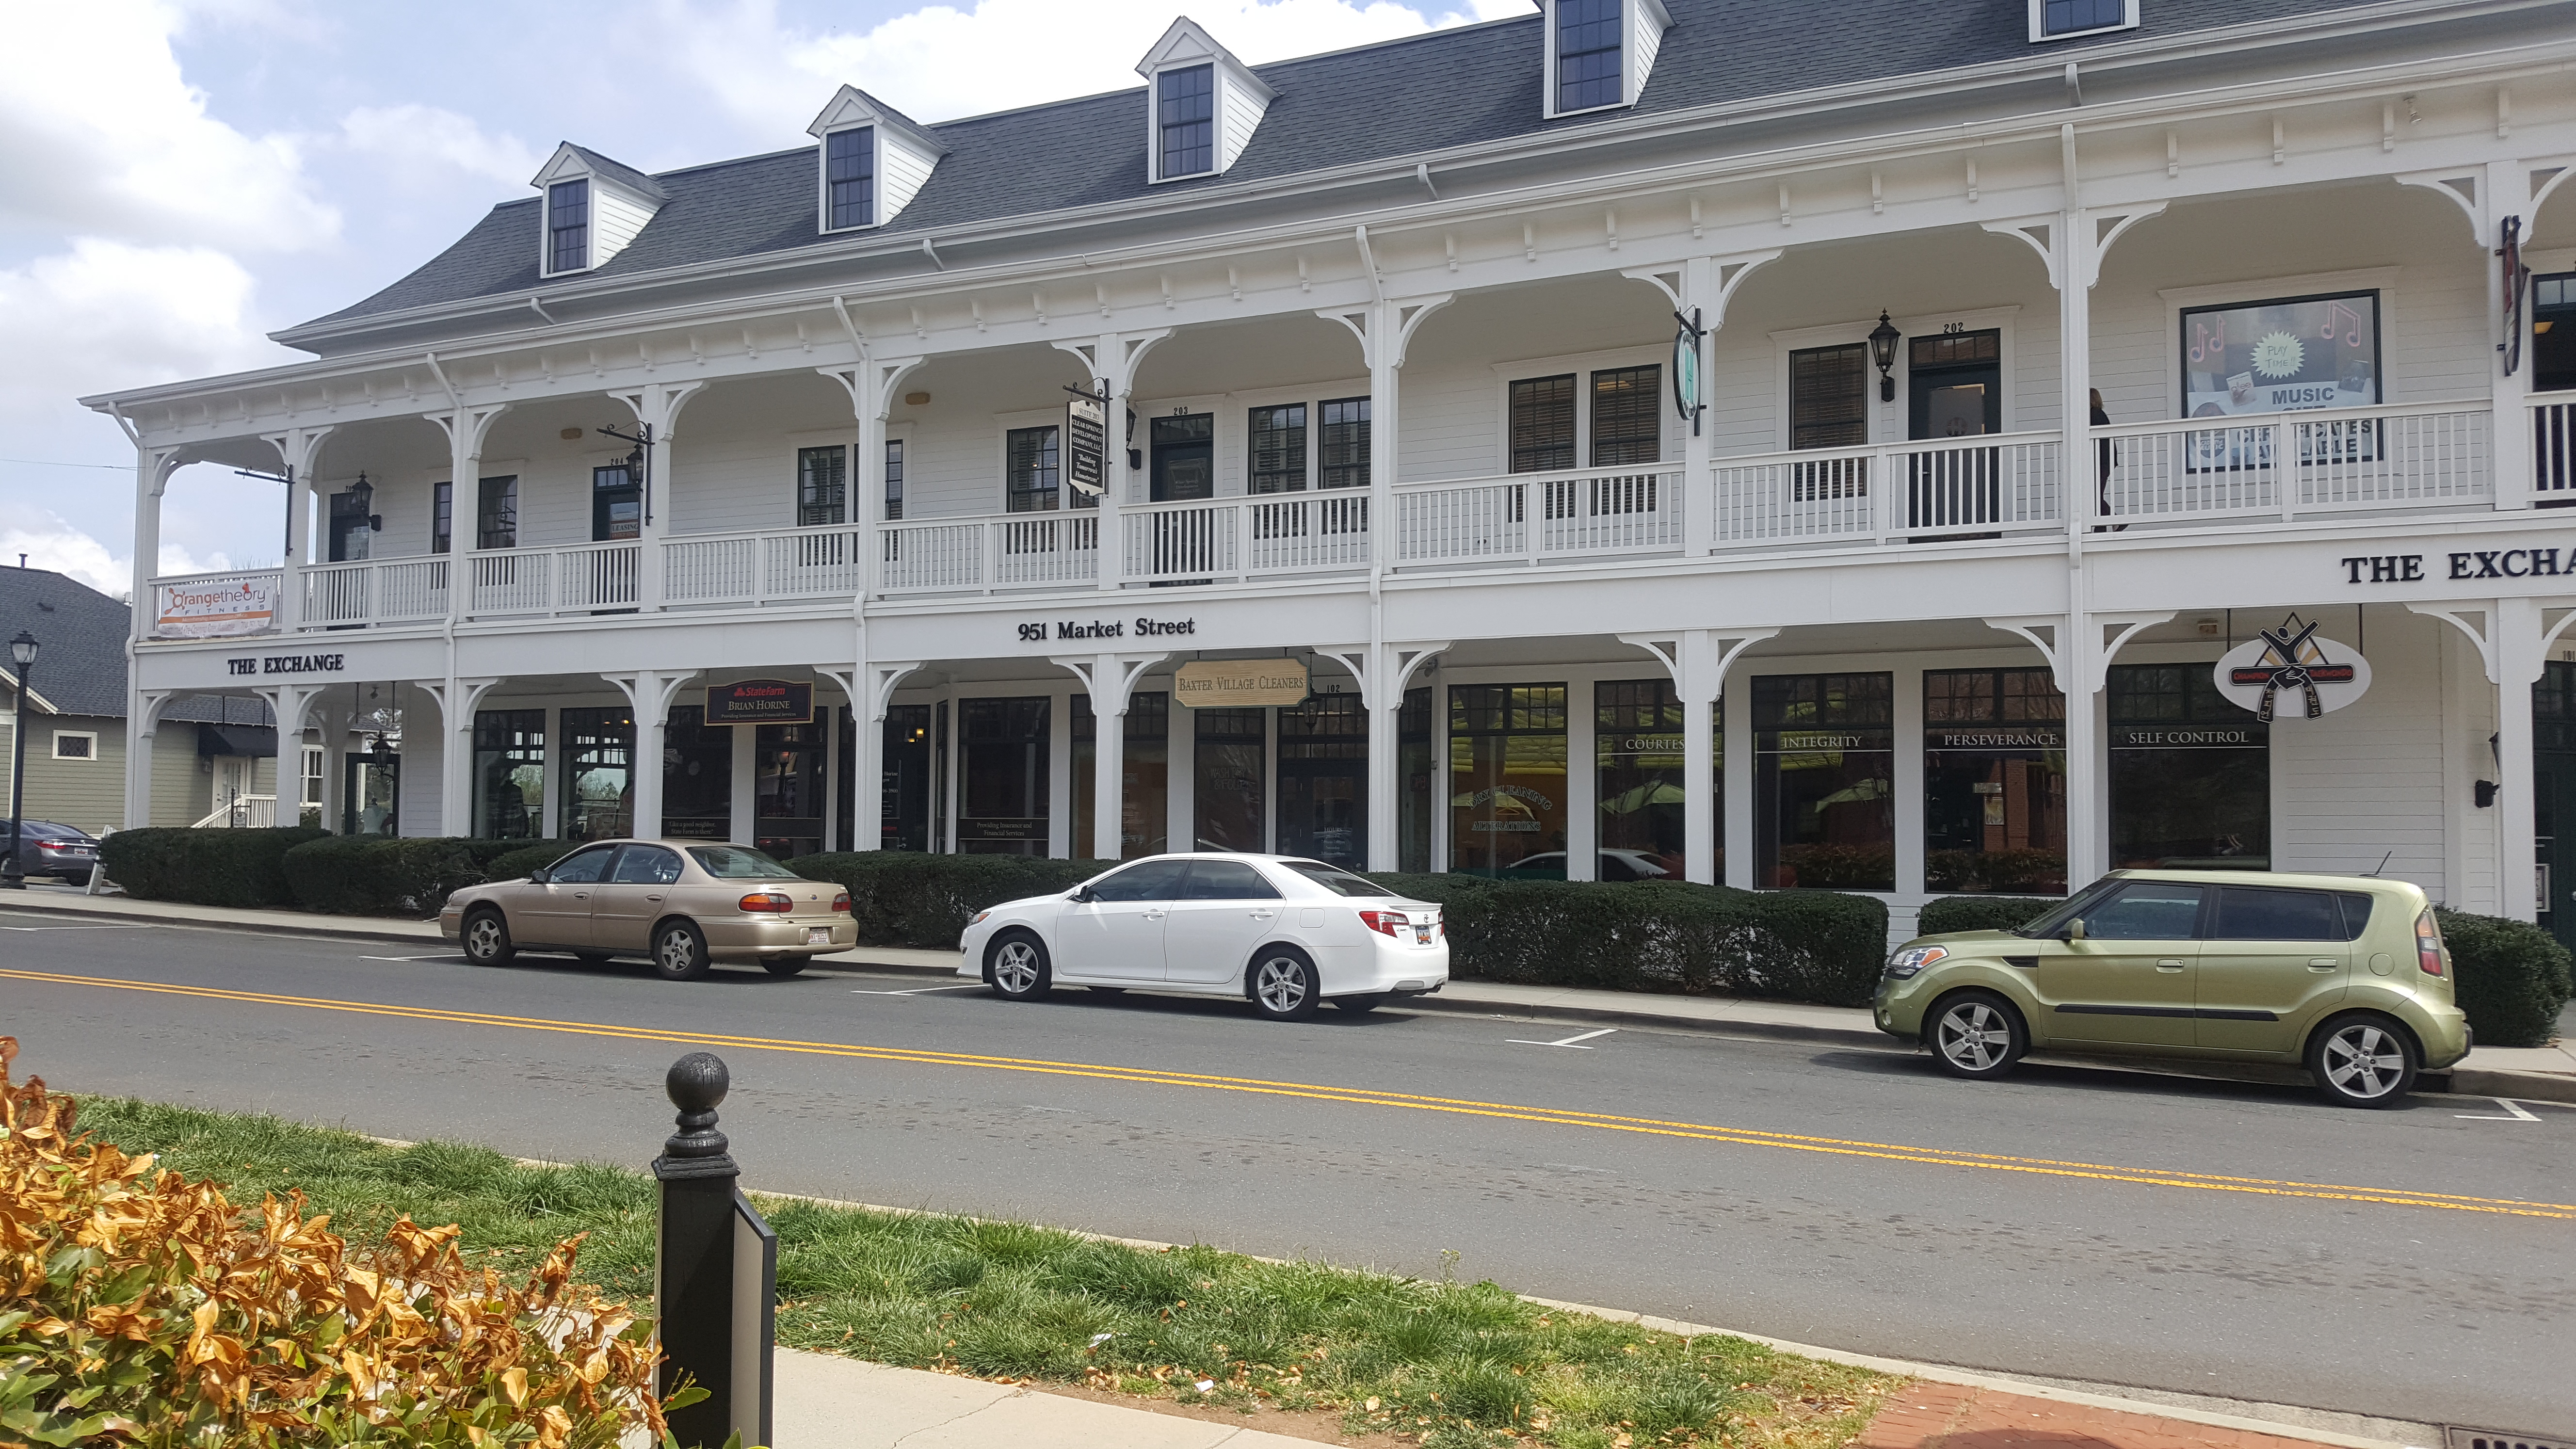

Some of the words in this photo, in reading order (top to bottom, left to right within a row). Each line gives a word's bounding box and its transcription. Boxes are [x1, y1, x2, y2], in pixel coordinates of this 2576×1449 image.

[1944, 322, 1964, 334] 202
[2268, 345, 2287, 356] PLAY
[2272, 387, 2334, 405] MUSIC
[1079, 408, 1092, 418] SUITE
[1174, 406, 1188, 415] 203
[1072, 419, 1085, 428] CLEAR
[1086, 423, 1102, 434] SPRINGS
[1072, 428, 1102, 443] DEVELOPMENT
[1073, 437, 1094, 449] COMPANY,
[2342, 554, 2425, 583] THE
[171, 588, 266, 610] Orangetheory
[185, 604, 265, 615] FITNESS
[1018, 623, 1047, 641] 951
[1058, 620, 1123, 639] Market
[1135, 617, 1195, 636] Street
[228, 659, 257, 675] THE
[264, 654, 344, 673] EXCHANGE
[1179, 678, 1213, 691] BAXTER
[1217, 677, 1255, 690] VILLAGE
[1259, 676, 1304, 689] CLEANERS
[728, 701, 755, 710] BRIAN
[756, 700, 790, 710] HORINE
[1784, 737, 1862, 748] INTEGRITY
[1945, 734, 2057, 745] PERSEVERANCE
[2129, 732, 2163, 743] SELF
[2168, 731, 2249, 743] CONTROL
[1626, 739, 1685, 749] COURTES
[1210, 768, 1229, 778] WASH
[1466, 789, 1490, 810] DRY
[1492, 785, 1552, 811] CLEANING
[1471, 821, 1541, 832] ALTERATIONS
